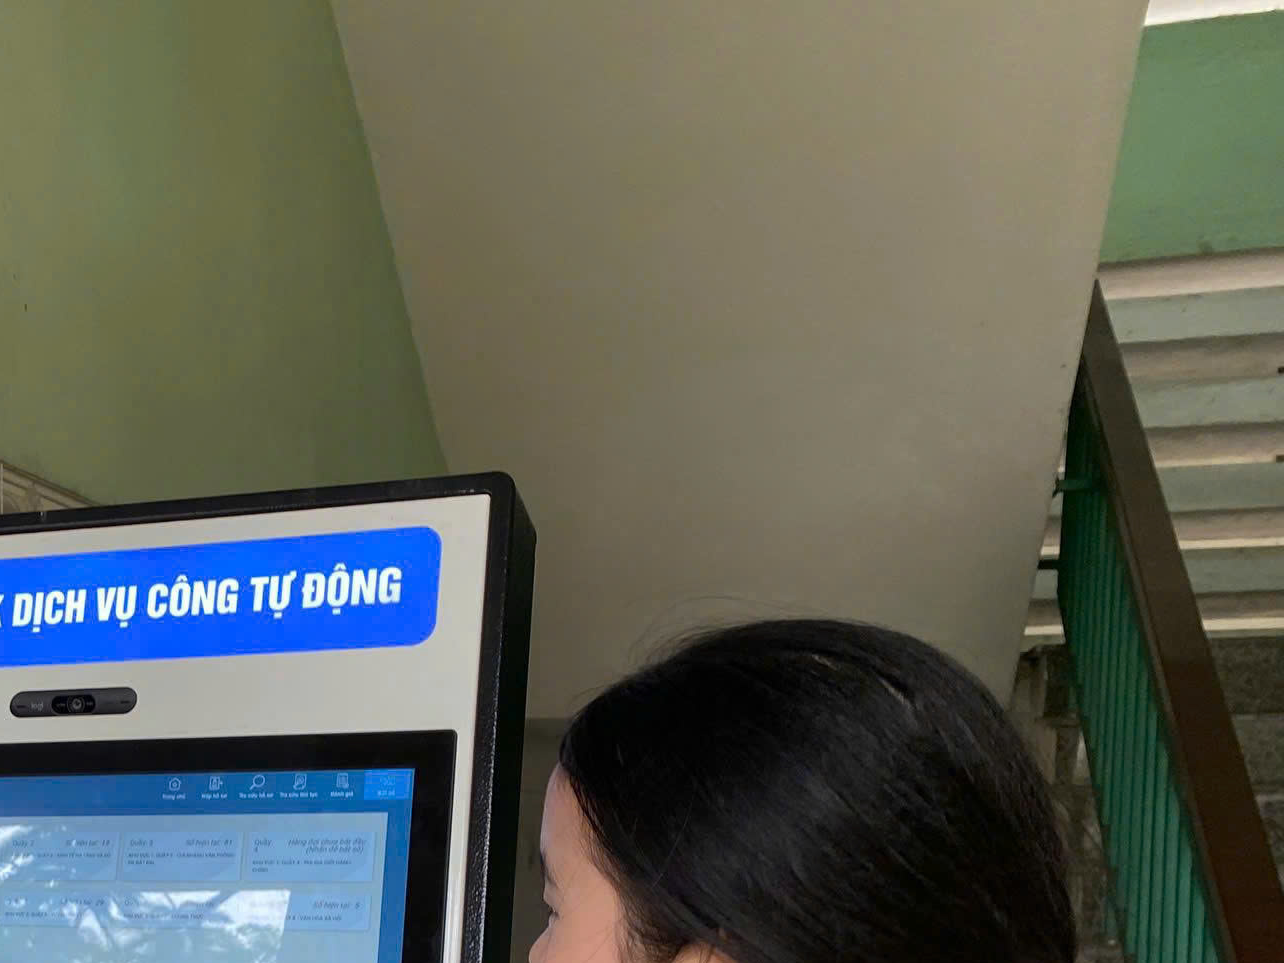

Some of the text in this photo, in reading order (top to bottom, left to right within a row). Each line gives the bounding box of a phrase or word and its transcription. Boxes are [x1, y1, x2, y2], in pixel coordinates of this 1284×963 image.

[12, 588, 88, 633] DỊCH
[96, 584, 138, 628] VỤ
[147, 574, 240, 619] CÔNG
[249, 570, 297, 619] TỰ
[302, 562, 403, 615] ĐỘNG
